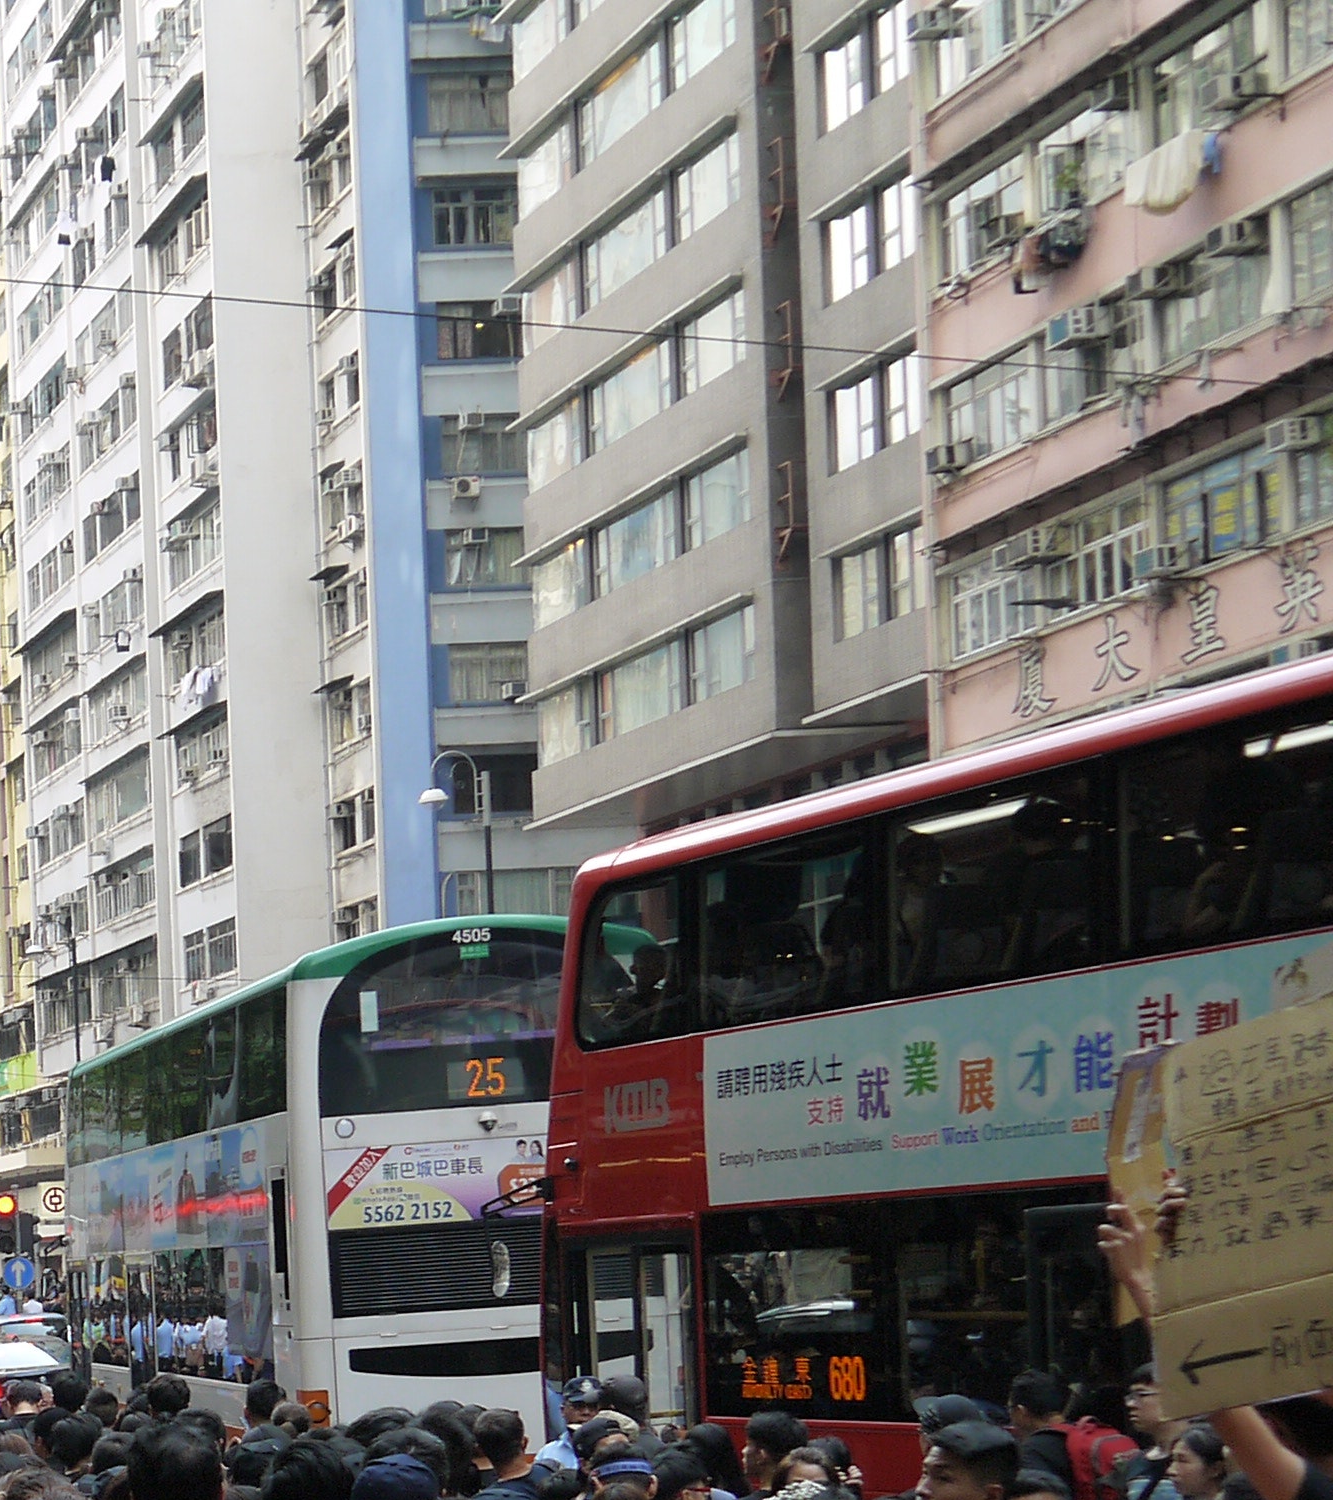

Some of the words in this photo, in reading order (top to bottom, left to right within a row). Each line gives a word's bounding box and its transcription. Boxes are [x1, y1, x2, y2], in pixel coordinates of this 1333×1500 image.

[452, 928, 491, 943] 4505
[465, 1057, 506, 1097] 25
[717, 1053, 843, 1099] 請聘用殘疾人士
[604, 1077, 669, 1134] KMB
[807, 1095, 843, 1125] 支持
[719, 1151, 754, 1168] Employ
[757, 1147, 798, 1163] Persons
[799, 1142, 821, 1158] with
[824, 1138, 883, 1156] Disabilities
[891, 1130, 939, 1150] Support
[941, 1125, 979, 1146] Work
[983, 1117, 1066, 1142] Orientation
[1071, 1112, 1100, 1134] and
[383, 1157, 483, 1180] 新巴城巴車長
[363, 1204, 405, 1223] 5562
[411, 1201, 453, 1220] 2152
[829, 1356, 865, 1400] 680
